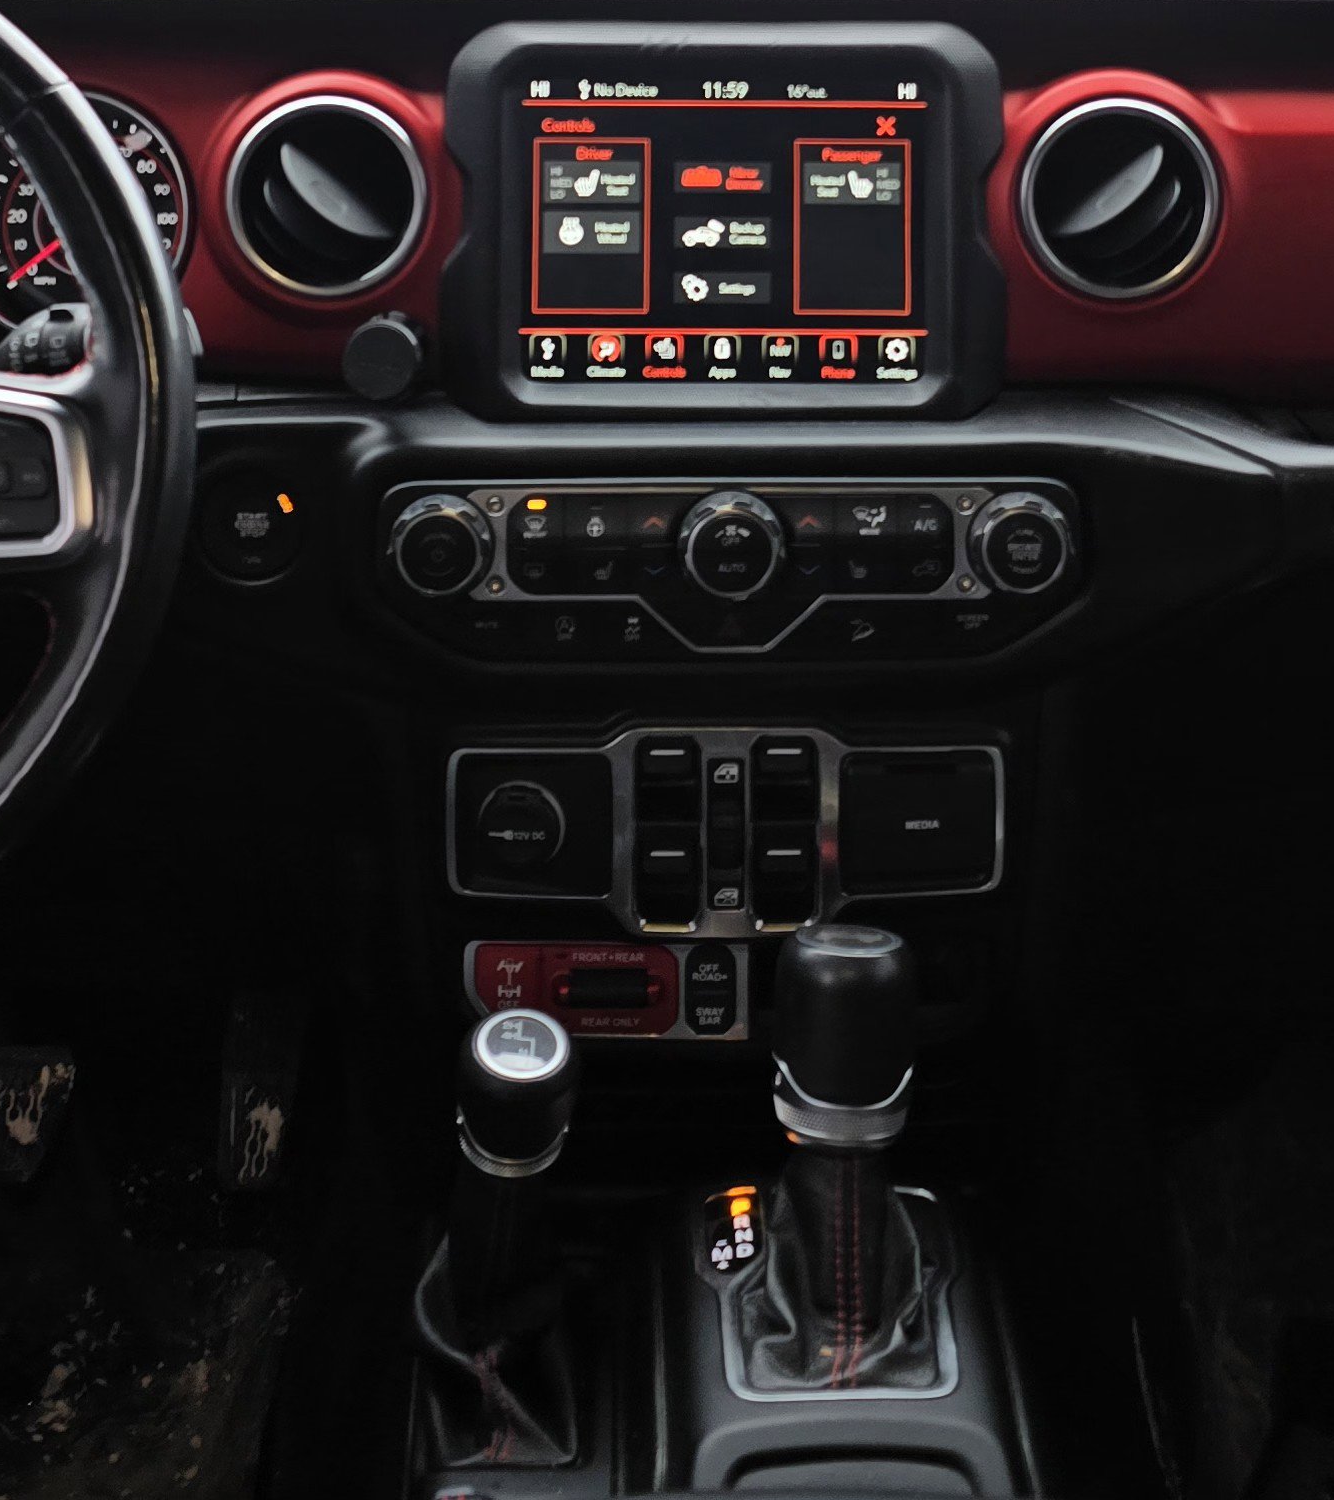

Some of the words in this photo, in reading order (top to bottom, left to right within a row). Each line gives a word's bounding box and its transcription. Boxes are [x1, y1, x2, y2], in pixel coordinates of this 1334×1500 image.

[530, 80, 551, 98] HI
[594, 82, 614, 97] No
[615, 82, 659, 97] Device
[702, 80, 750, 99] 11:59
[897, 82, 917, 100] HI
[541, 117, 596, 132] Controls
[575, 145, 615, 161] Driver
[136, 159, 157, 175] 80
[17, 183, 36, 197] 30
[154, 183, 171, 197] 90
[6, 208, 28, 224] 20
[157, 212, 179, 226] 100
[14, 238, 28, 251] 10
[912, 518, 938, 532] A/C
[717, 561, 748, 573] AUTO
[905, 819, 940, 831] MEDIA
[695, 1007, 725, 1017] SWAY
[580, 1018, 611, 1027] REAR
[613, 1018, 641, 1028] ONLY
[698, 1017, 721, 1026] BAR
